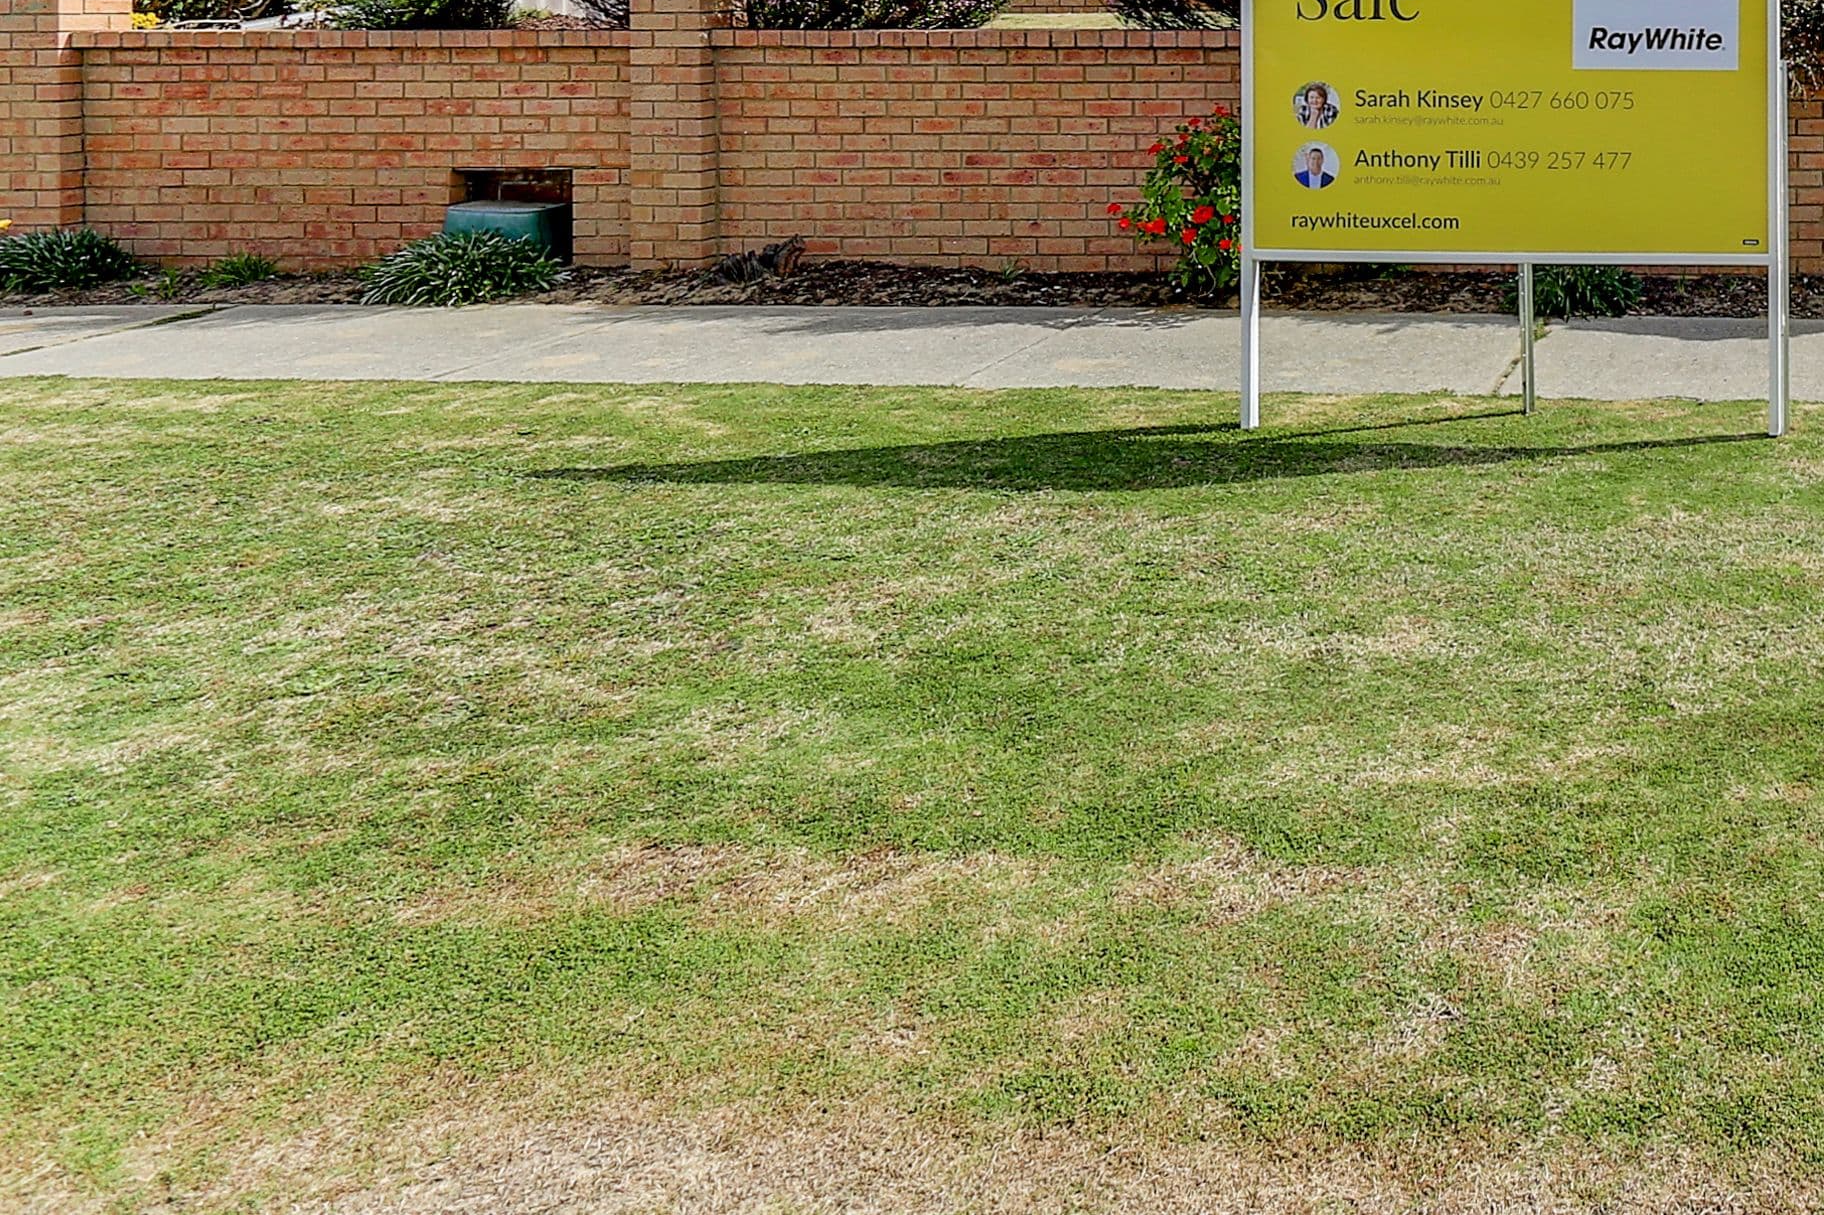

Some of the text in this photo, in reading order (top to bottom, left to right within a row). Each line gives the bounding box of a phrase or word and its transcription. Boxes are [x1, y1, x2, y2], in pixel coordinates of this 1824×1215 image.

[1355, 89, 1635, 112] Sarah Kinsey 0427 660 075
[1354, 150, 1632, 171] Anthony Tilli 0439 257 477
[1291, 212, 1460, 231] raywhiteuxcel.com
